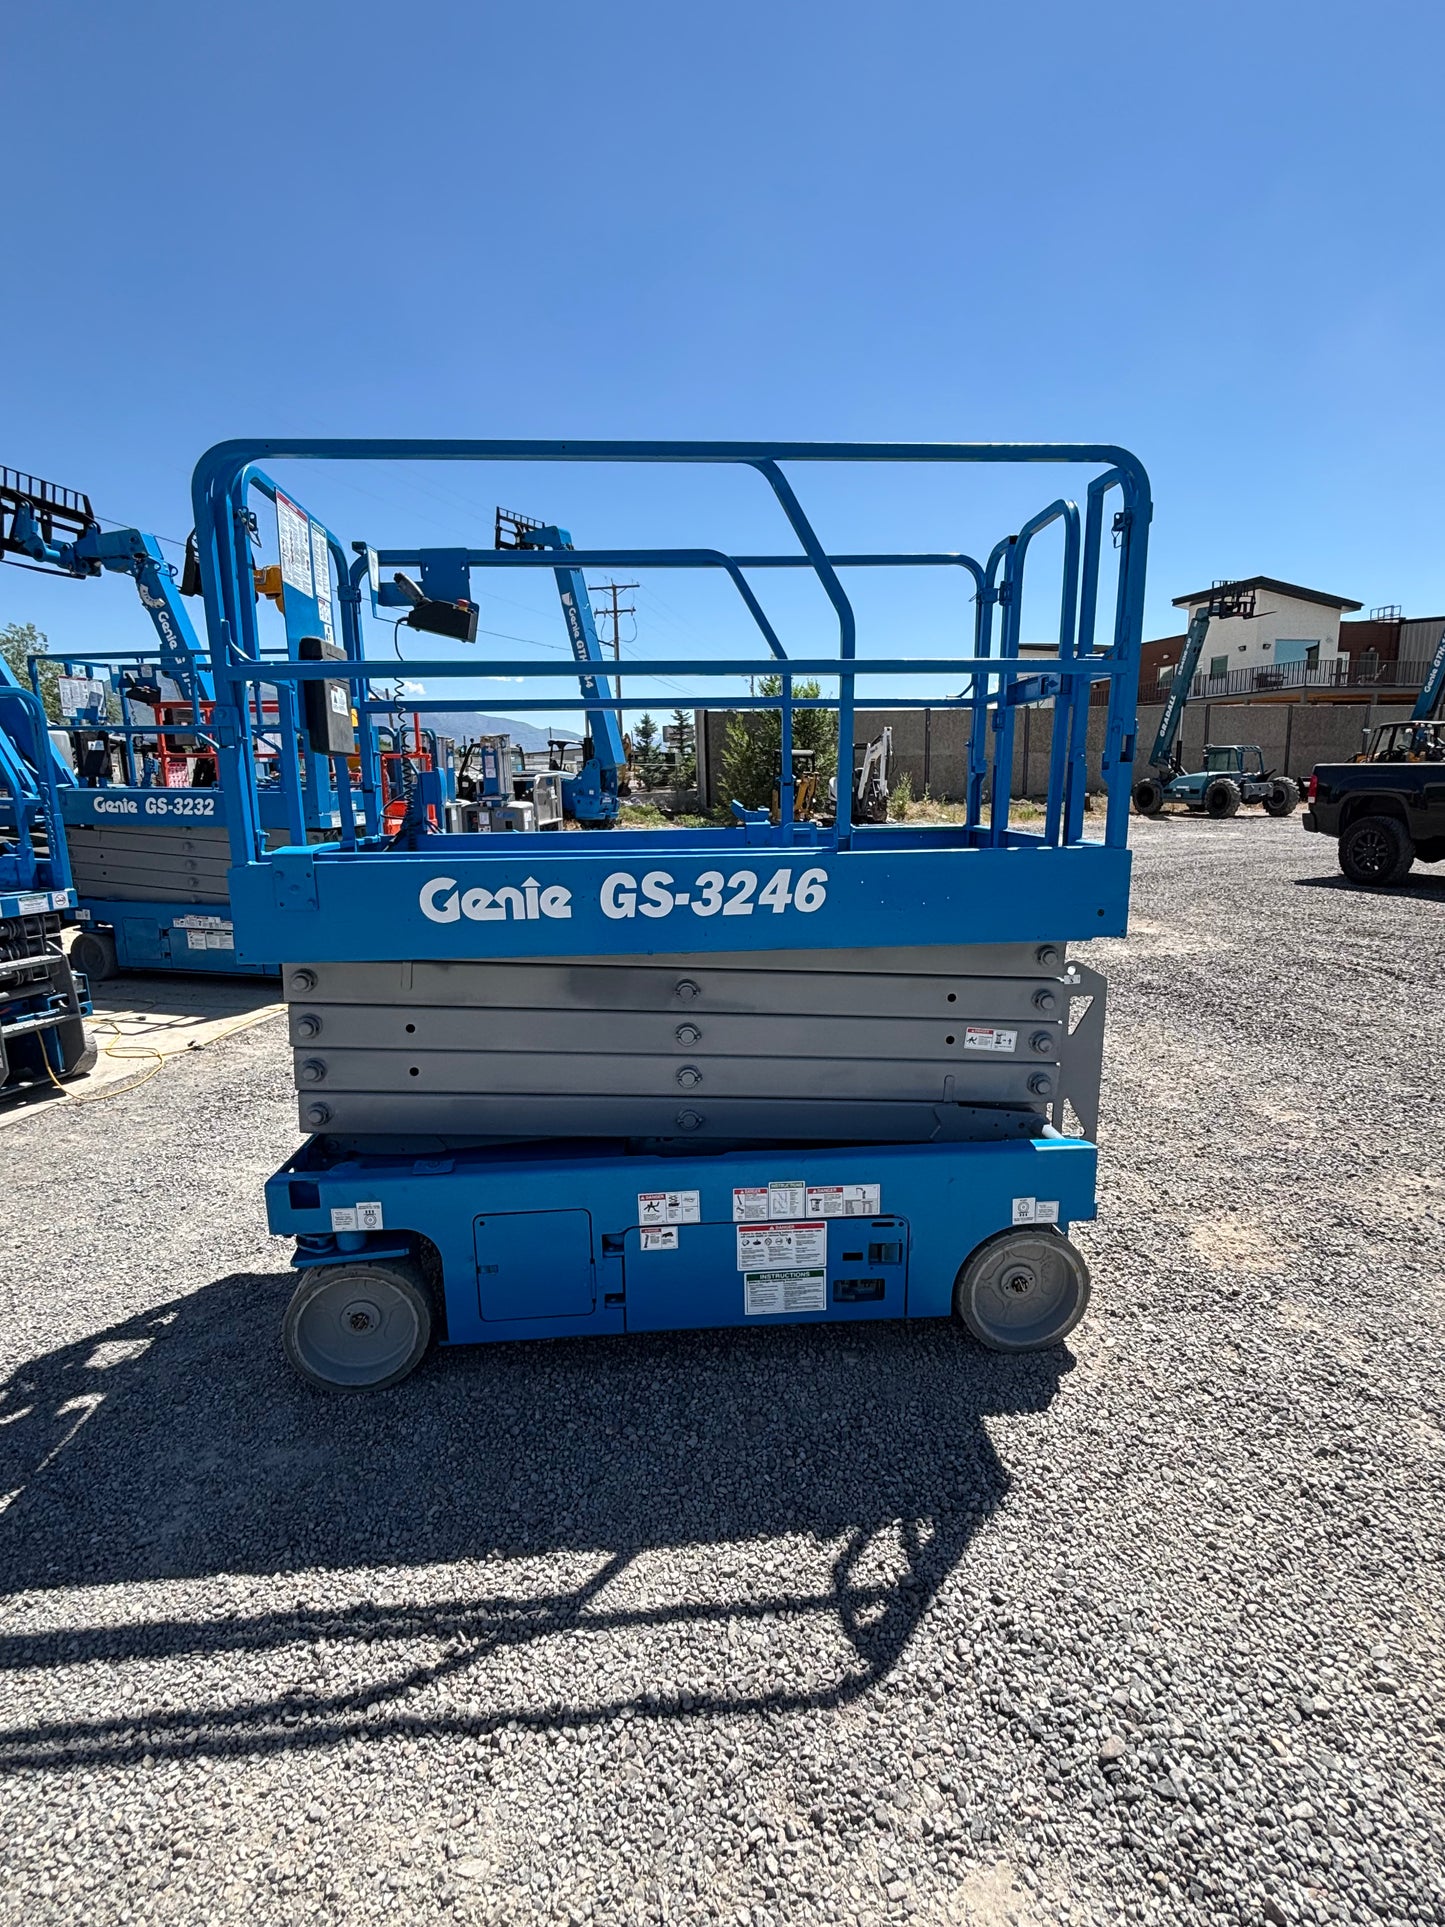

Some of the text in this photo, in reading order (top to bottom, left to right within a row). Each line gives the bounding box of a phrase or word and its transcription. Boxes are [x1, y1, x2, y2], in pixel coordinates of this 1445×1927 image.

[158, 611, 178, 650] Genie
[569, 607, 581, 639] Genie
[1424, 668, 1438, 693] Genie
[1160, 695, 1177, 737] GRADALL
[93, 796, 215, 816] Genie GS-3232
[419, 868, 829, 924] Genie GS-3246
[760, 1271, 811, 1280] INSTRUCTIONS
